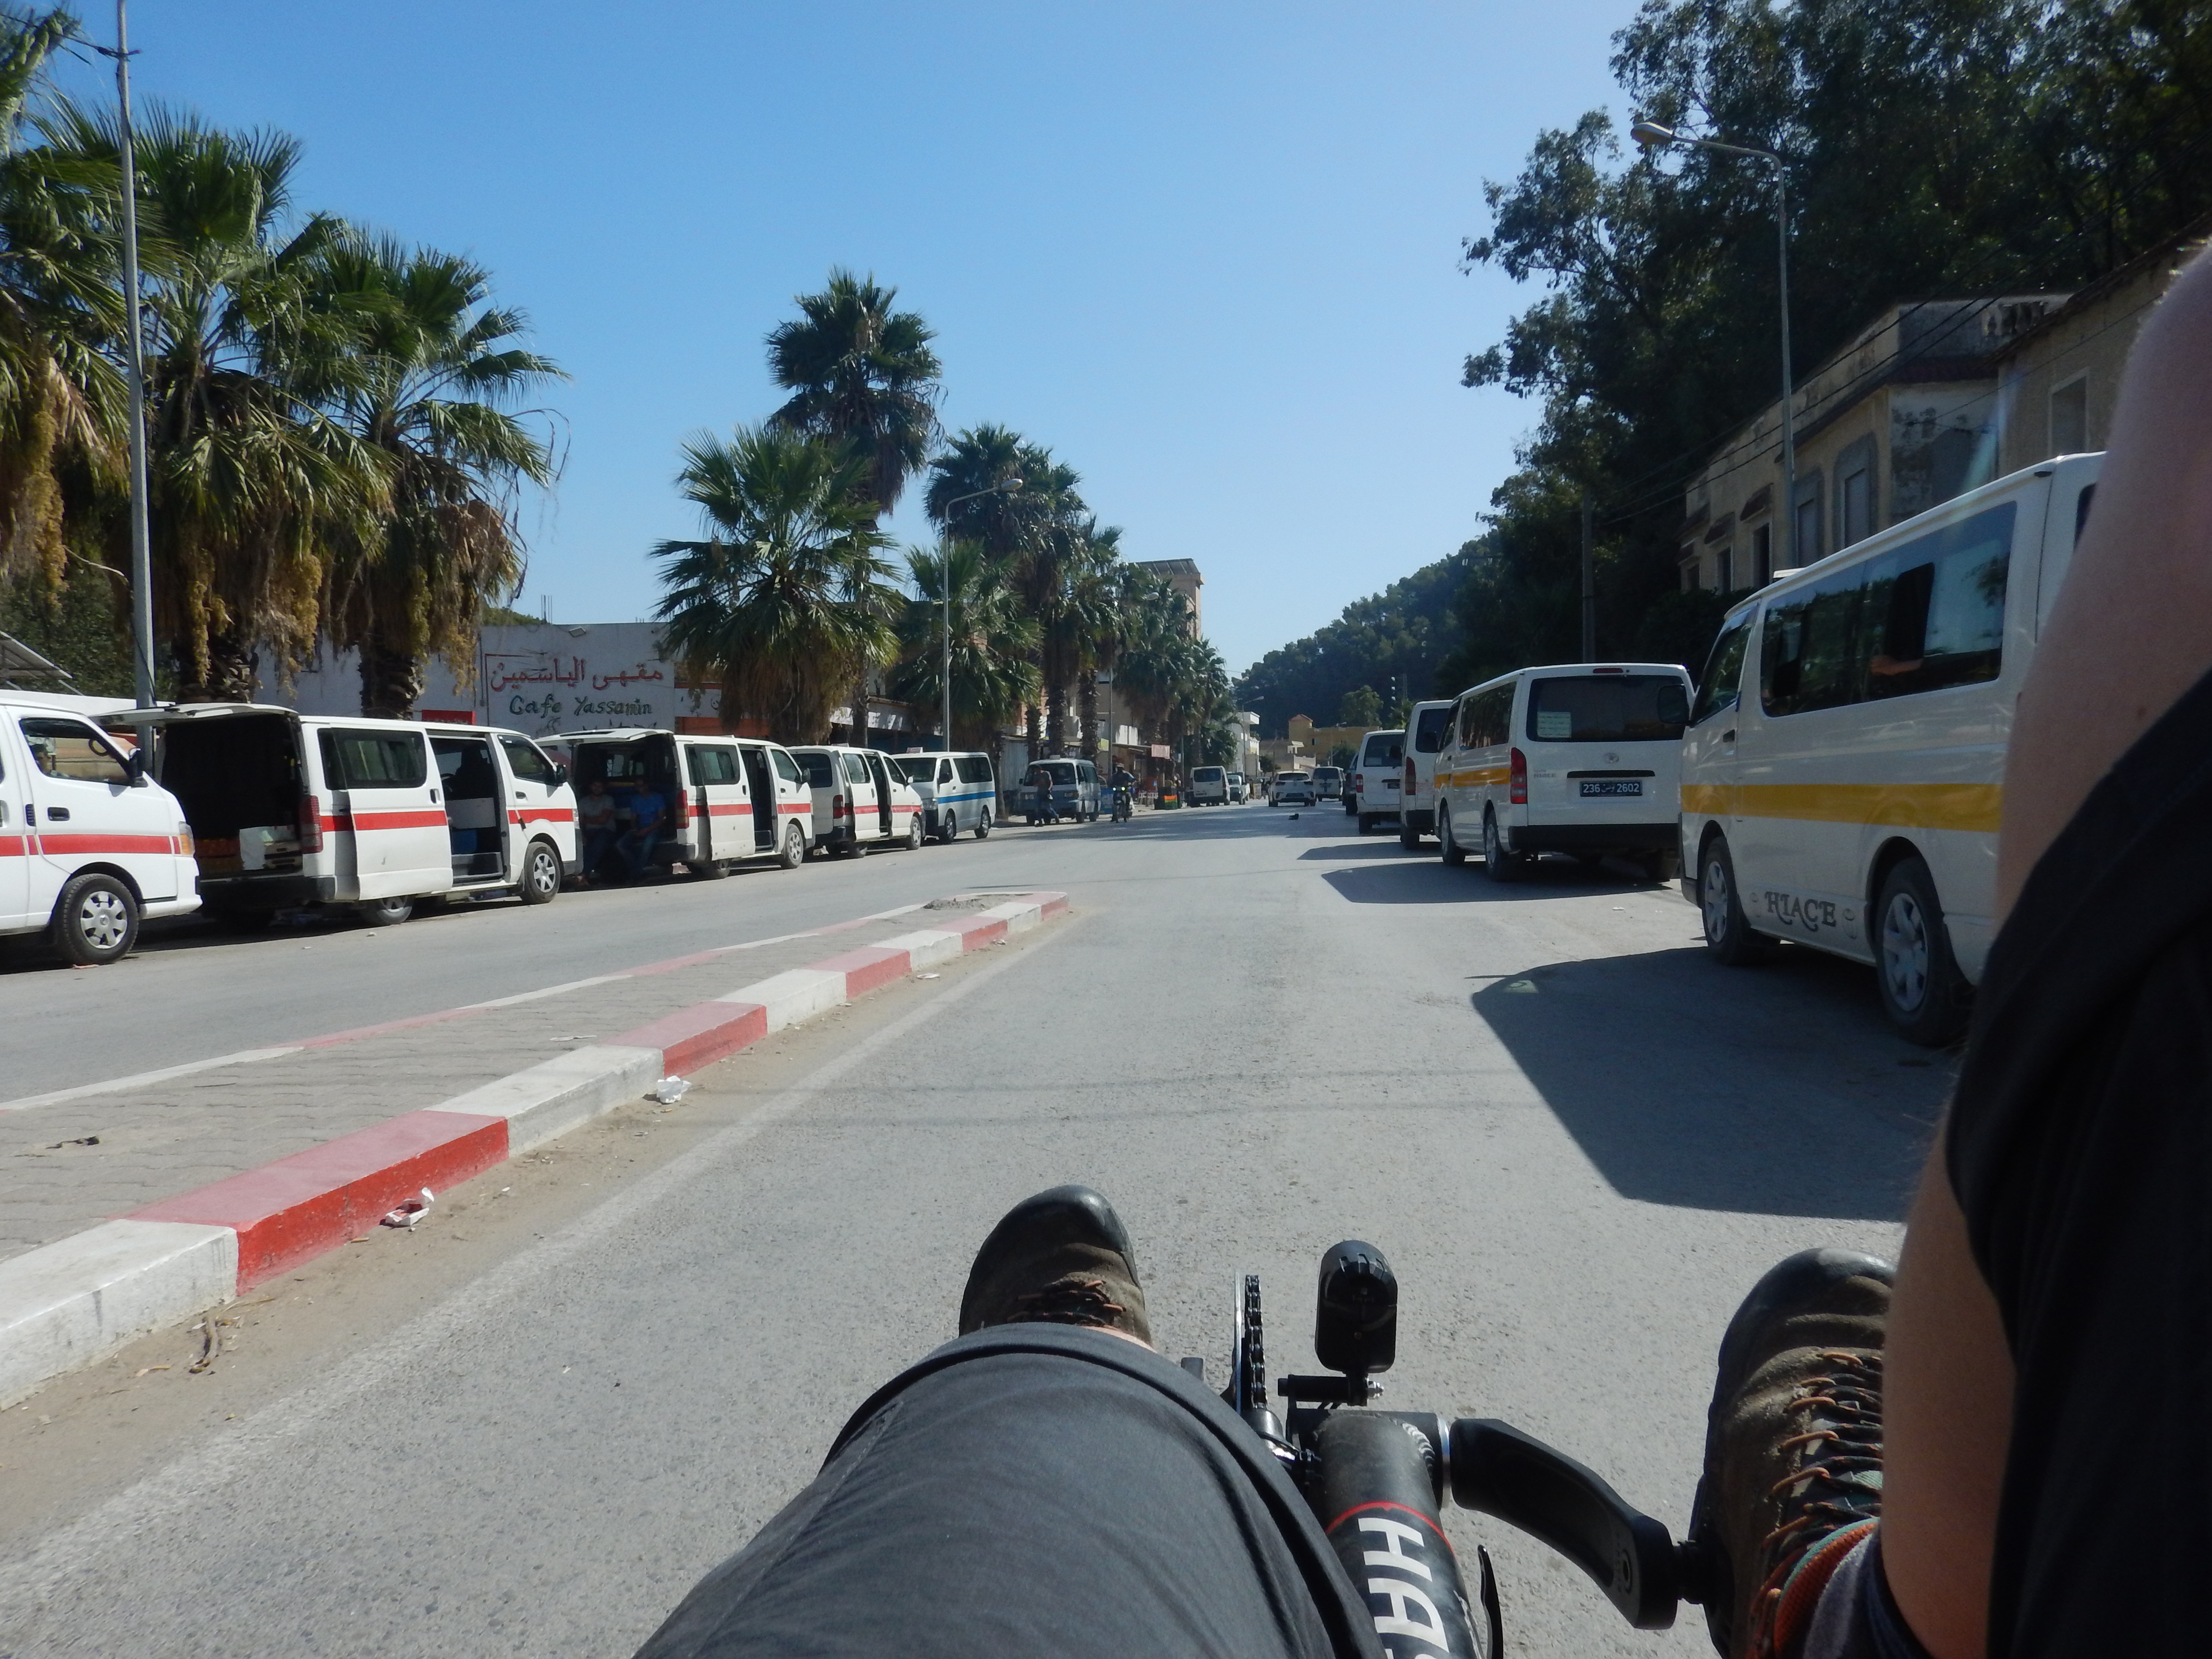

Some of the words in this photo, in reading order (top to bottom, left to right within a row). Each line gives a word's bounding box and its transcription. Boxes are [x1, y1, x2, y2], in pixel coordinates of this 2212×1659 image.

[491, 656, 585, 692] الياسمين
[592, 664, 663, 690] مقهى
[1583, 783, 1600, 793] 236
[1617, 783, 1640, 793] 2602
[1765, 891, 1837, 932] HIACE
[1358, 1517, 1450, 1659] HA
